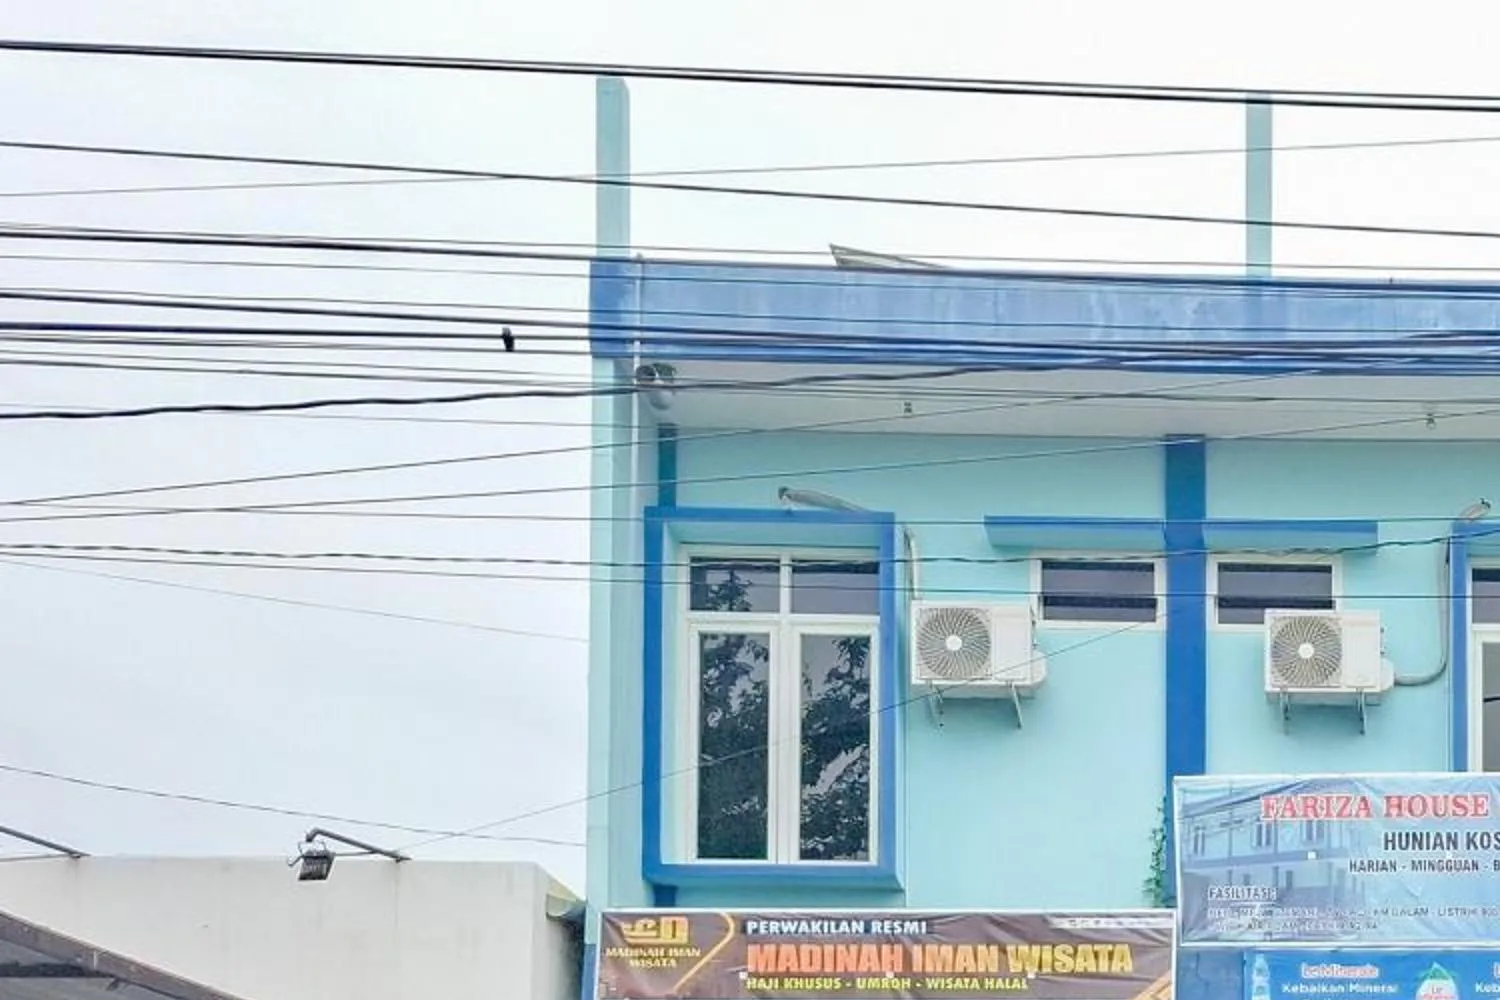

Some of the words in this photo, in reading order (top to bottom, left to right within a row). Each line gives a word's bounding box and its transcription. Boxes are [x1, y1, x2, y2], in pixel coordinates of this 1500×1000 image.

[1261, 794, 1373, 819] FARIZA
[1383, 794, 1489, 818] HOUSE
[1384, 831, 1456, 850] HUNIAN
[1349, 859, 1397, 872] HARIAN
[1411, 859, 1479, 872] MINGGUAN
[747, 920, 866, 934] PERWAKILAN
[871, 921, 927, 934] RESMI
[747, 944, 903, 972] MADINAH
[911, 944, 998, 972] IMAN
[1006, 944, 1133, 973] WISATA
[747, 977, 779, 990] HAJI
[784, 977, 842, 990] KHUSUS
[856, 977, 911, 990] UMROH
[926, 977, 980, 990] WISATA
[984, 977, 1028, 990] HALAL
[1282, 983, 1345, 994] Kebaikan
